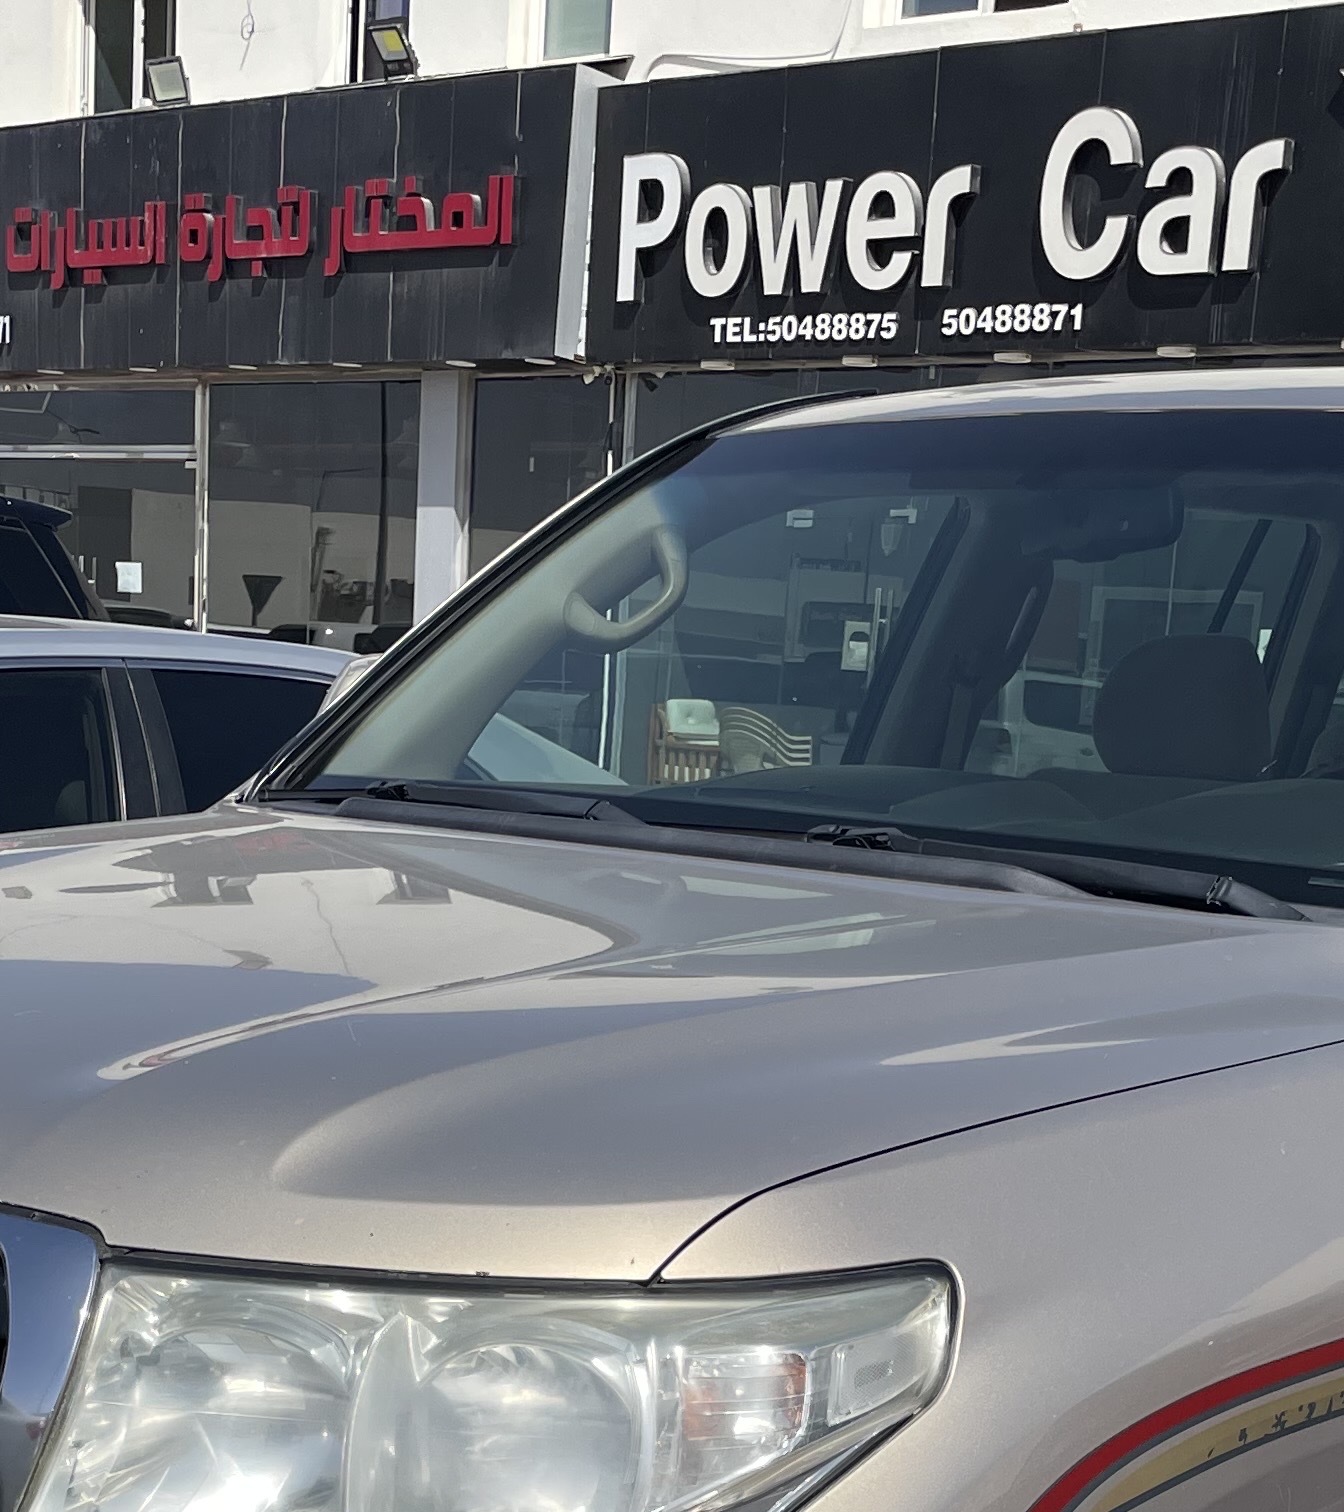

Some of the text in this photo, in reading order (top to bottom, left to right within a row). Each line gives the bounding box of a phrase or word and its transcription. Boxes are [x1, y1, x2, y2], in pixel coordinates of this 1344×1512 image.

[6, 174, 515, 290] المختار لتجارة السيارات
[616, 105, 1295, 304] Power Car
[709, 303, 1084, 346] TEL:50488875 50488871
